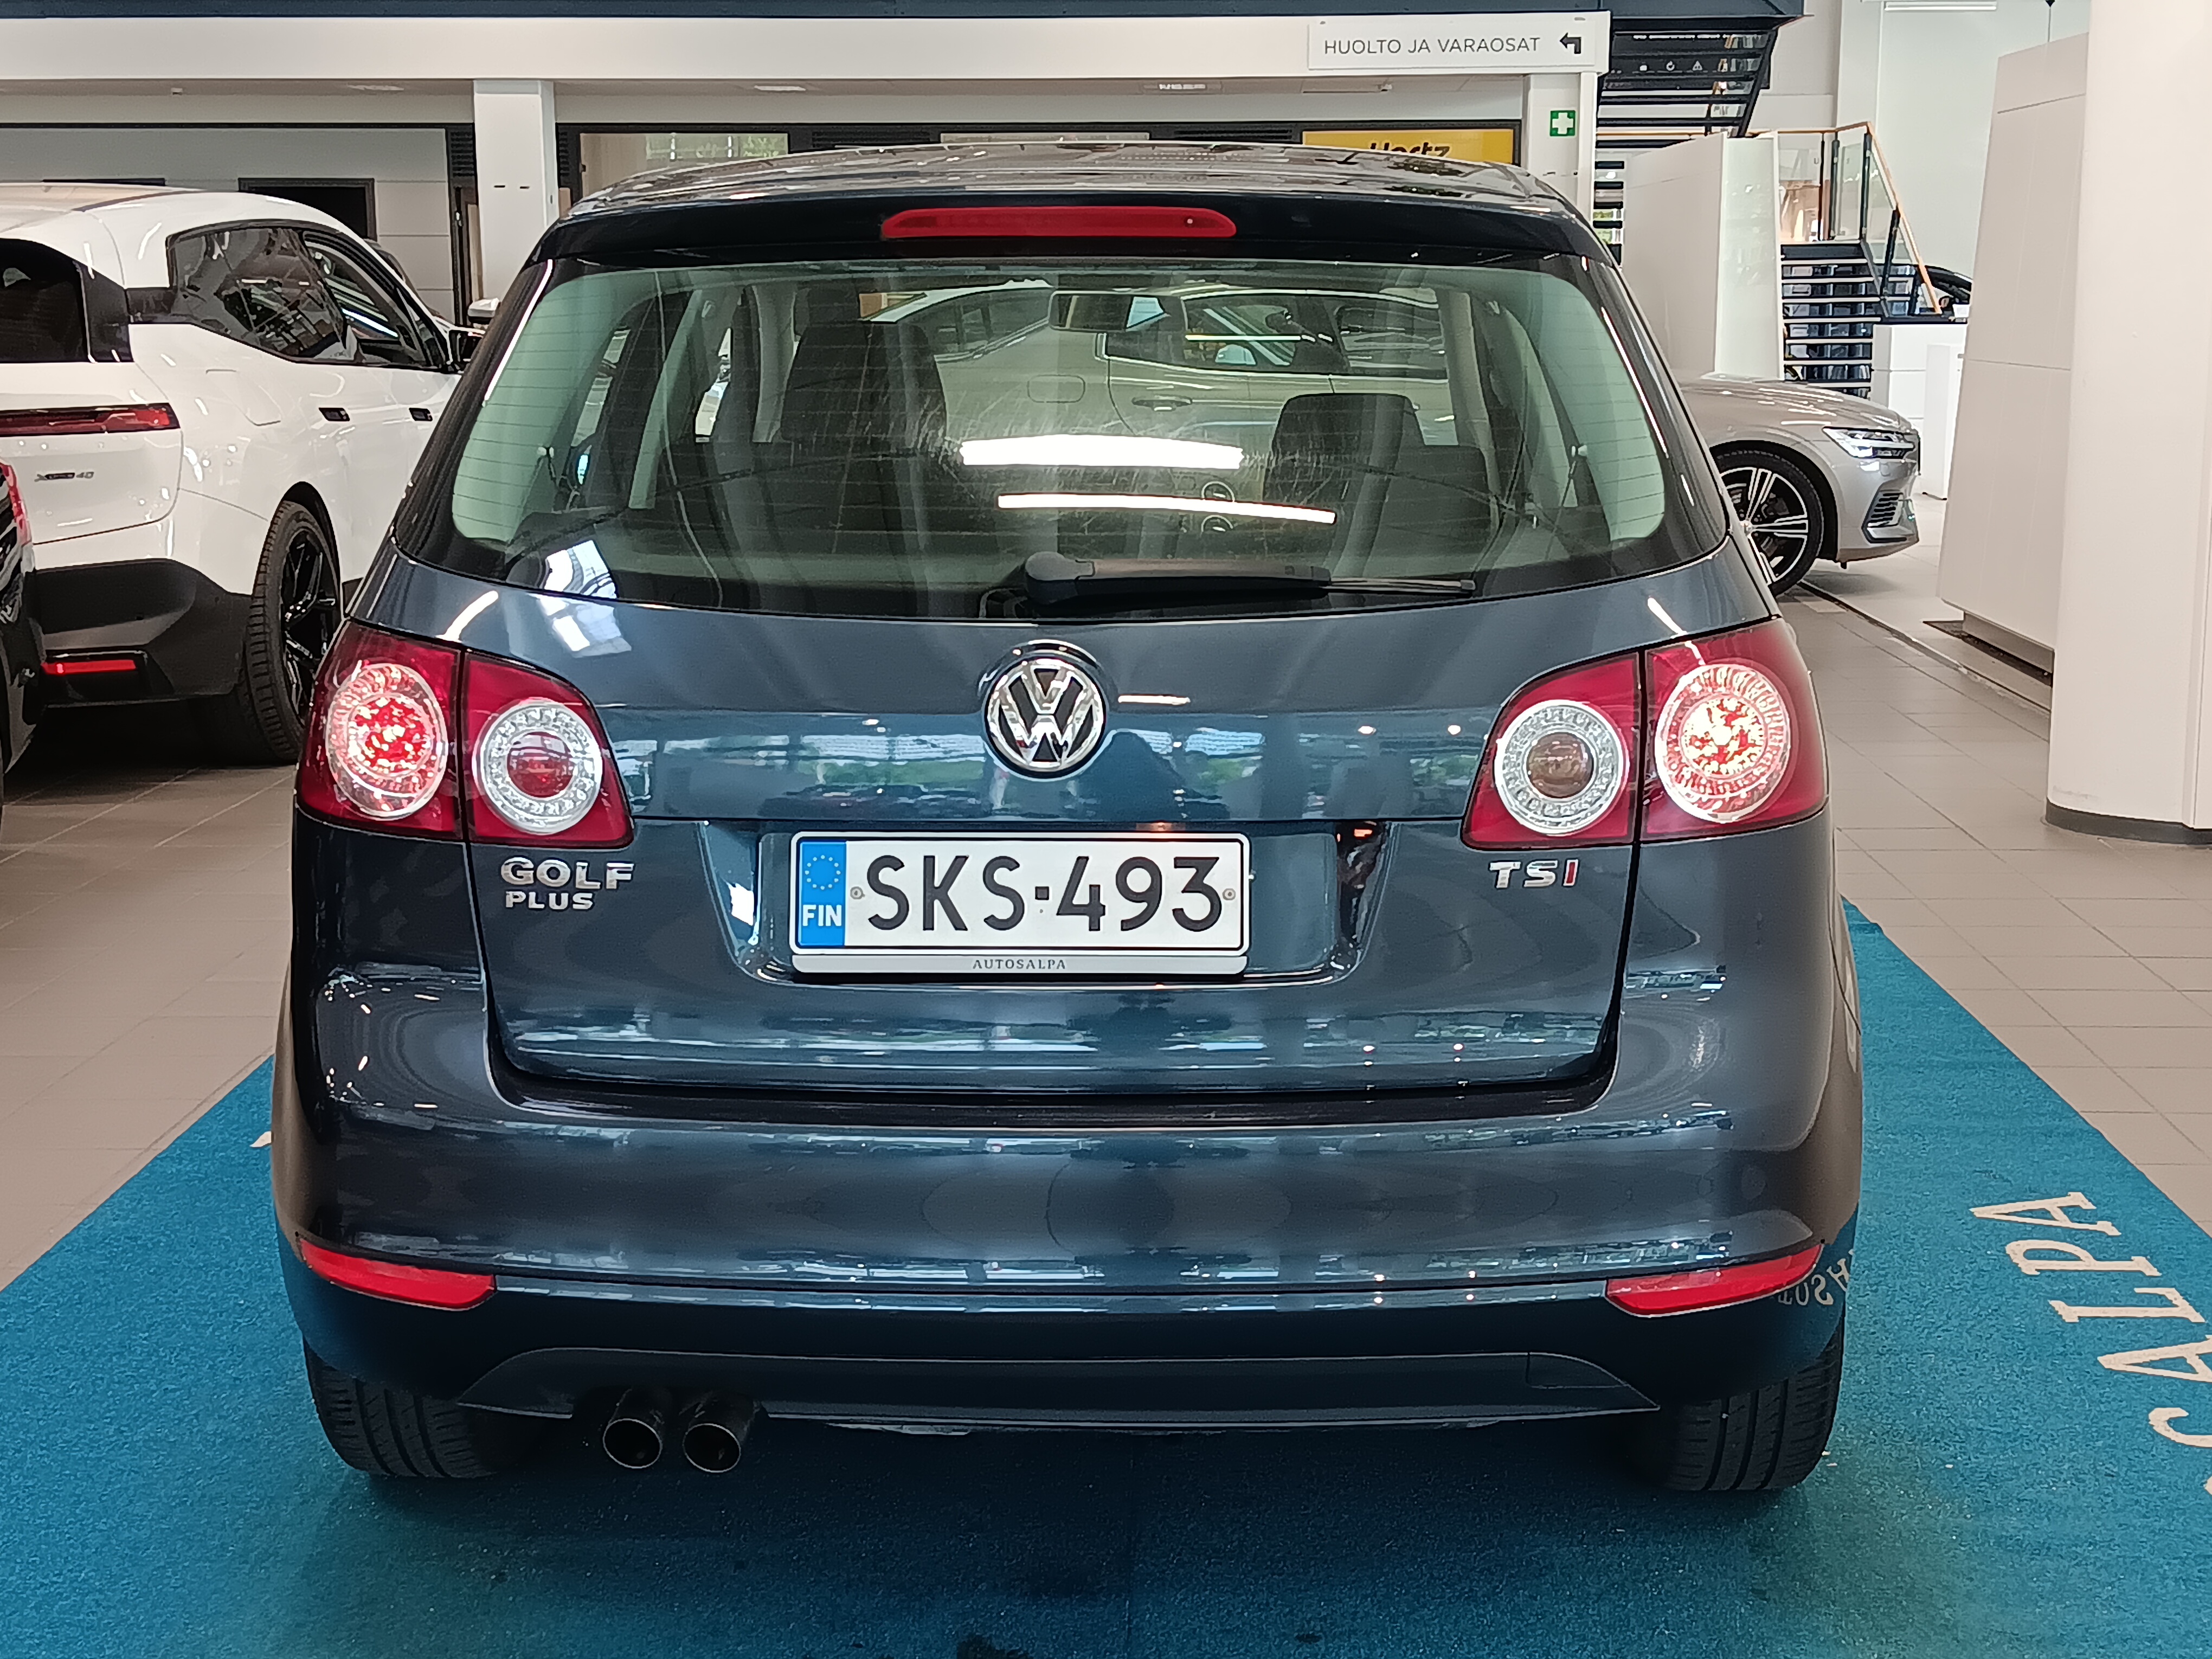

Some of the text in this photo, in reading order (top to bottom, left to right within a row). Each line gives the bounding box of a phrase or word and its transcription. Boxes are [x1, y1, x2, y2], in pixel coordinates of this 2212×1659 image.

[1324, 37, 1541, 55] HUOLTO JA VARAOSAT
[500, 856, 635, 889] GOLF
[1489, 858, 1579, 889] TSI
[505, 890, 594, 910] PLUS
[802, 904, 842, 927] FIN
[972, 959, 1066, 970] AUTOSALPA
